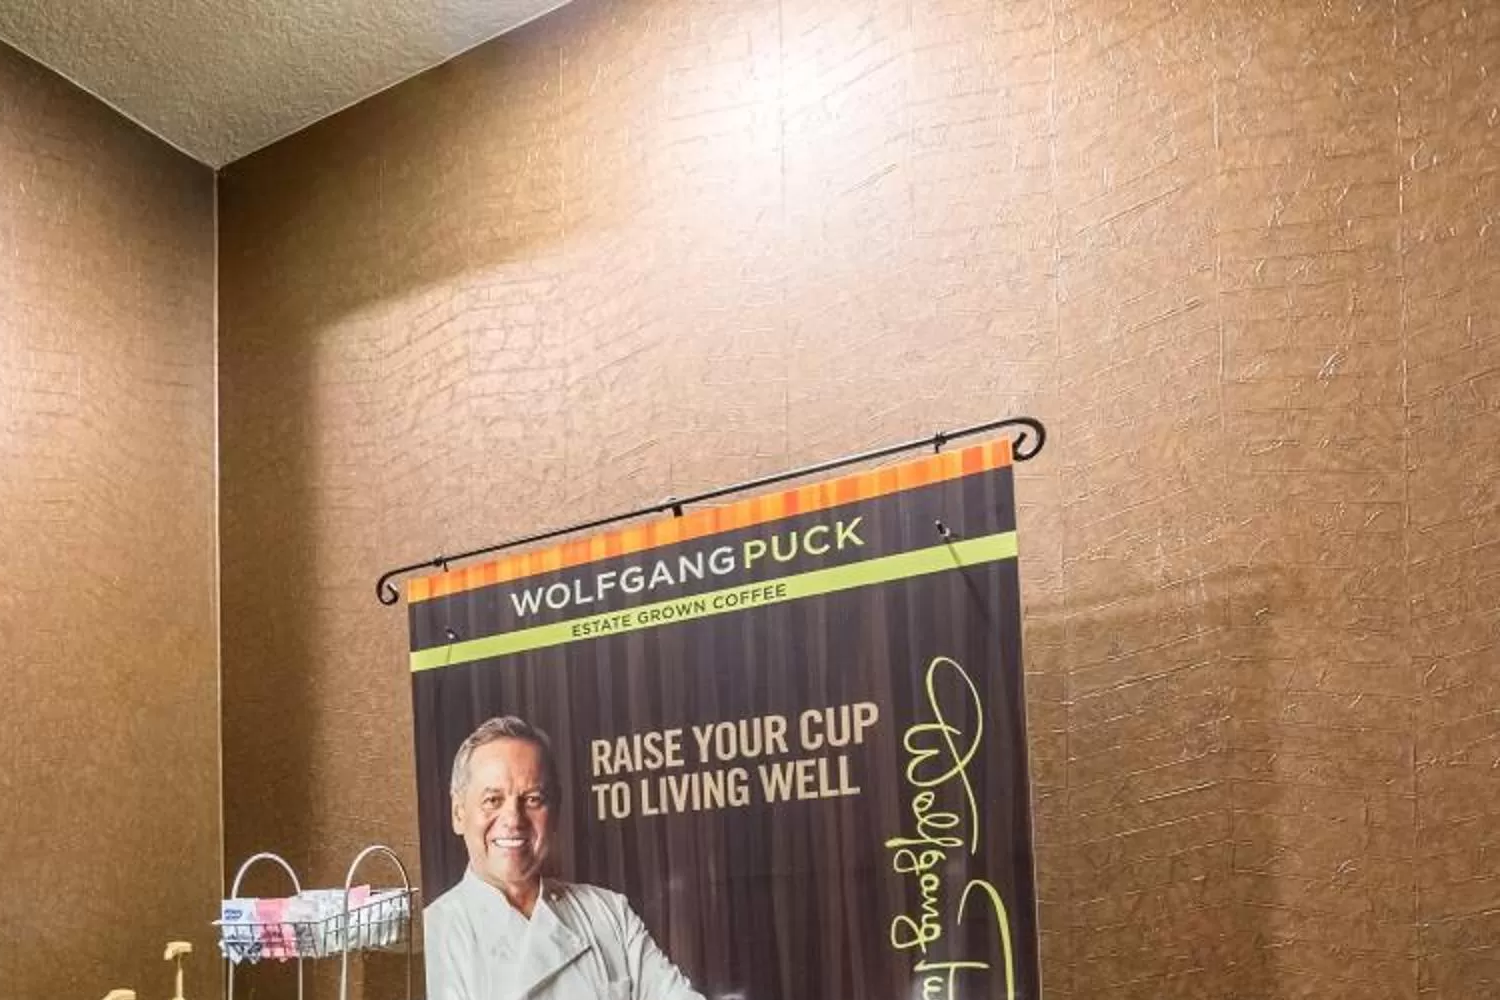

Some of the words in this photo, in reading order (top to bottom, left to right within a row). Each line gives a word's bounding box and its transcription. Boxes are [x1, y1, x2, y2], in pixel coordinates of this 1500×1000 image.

[571, 617, 632, 638] ESTATE
[637, 599, 706, 626] GROWN
[712, 583, 788, 610] COFFEE
[591, 728, 685, 777] RAISE
[691, 715, 789, 763] YOUR
[800, 701, 880, 751] CUP
[591, 781, 631, 821] TO
[641, 767, 750, 816] LIVING
[758, 755, 861, 803] WELL
